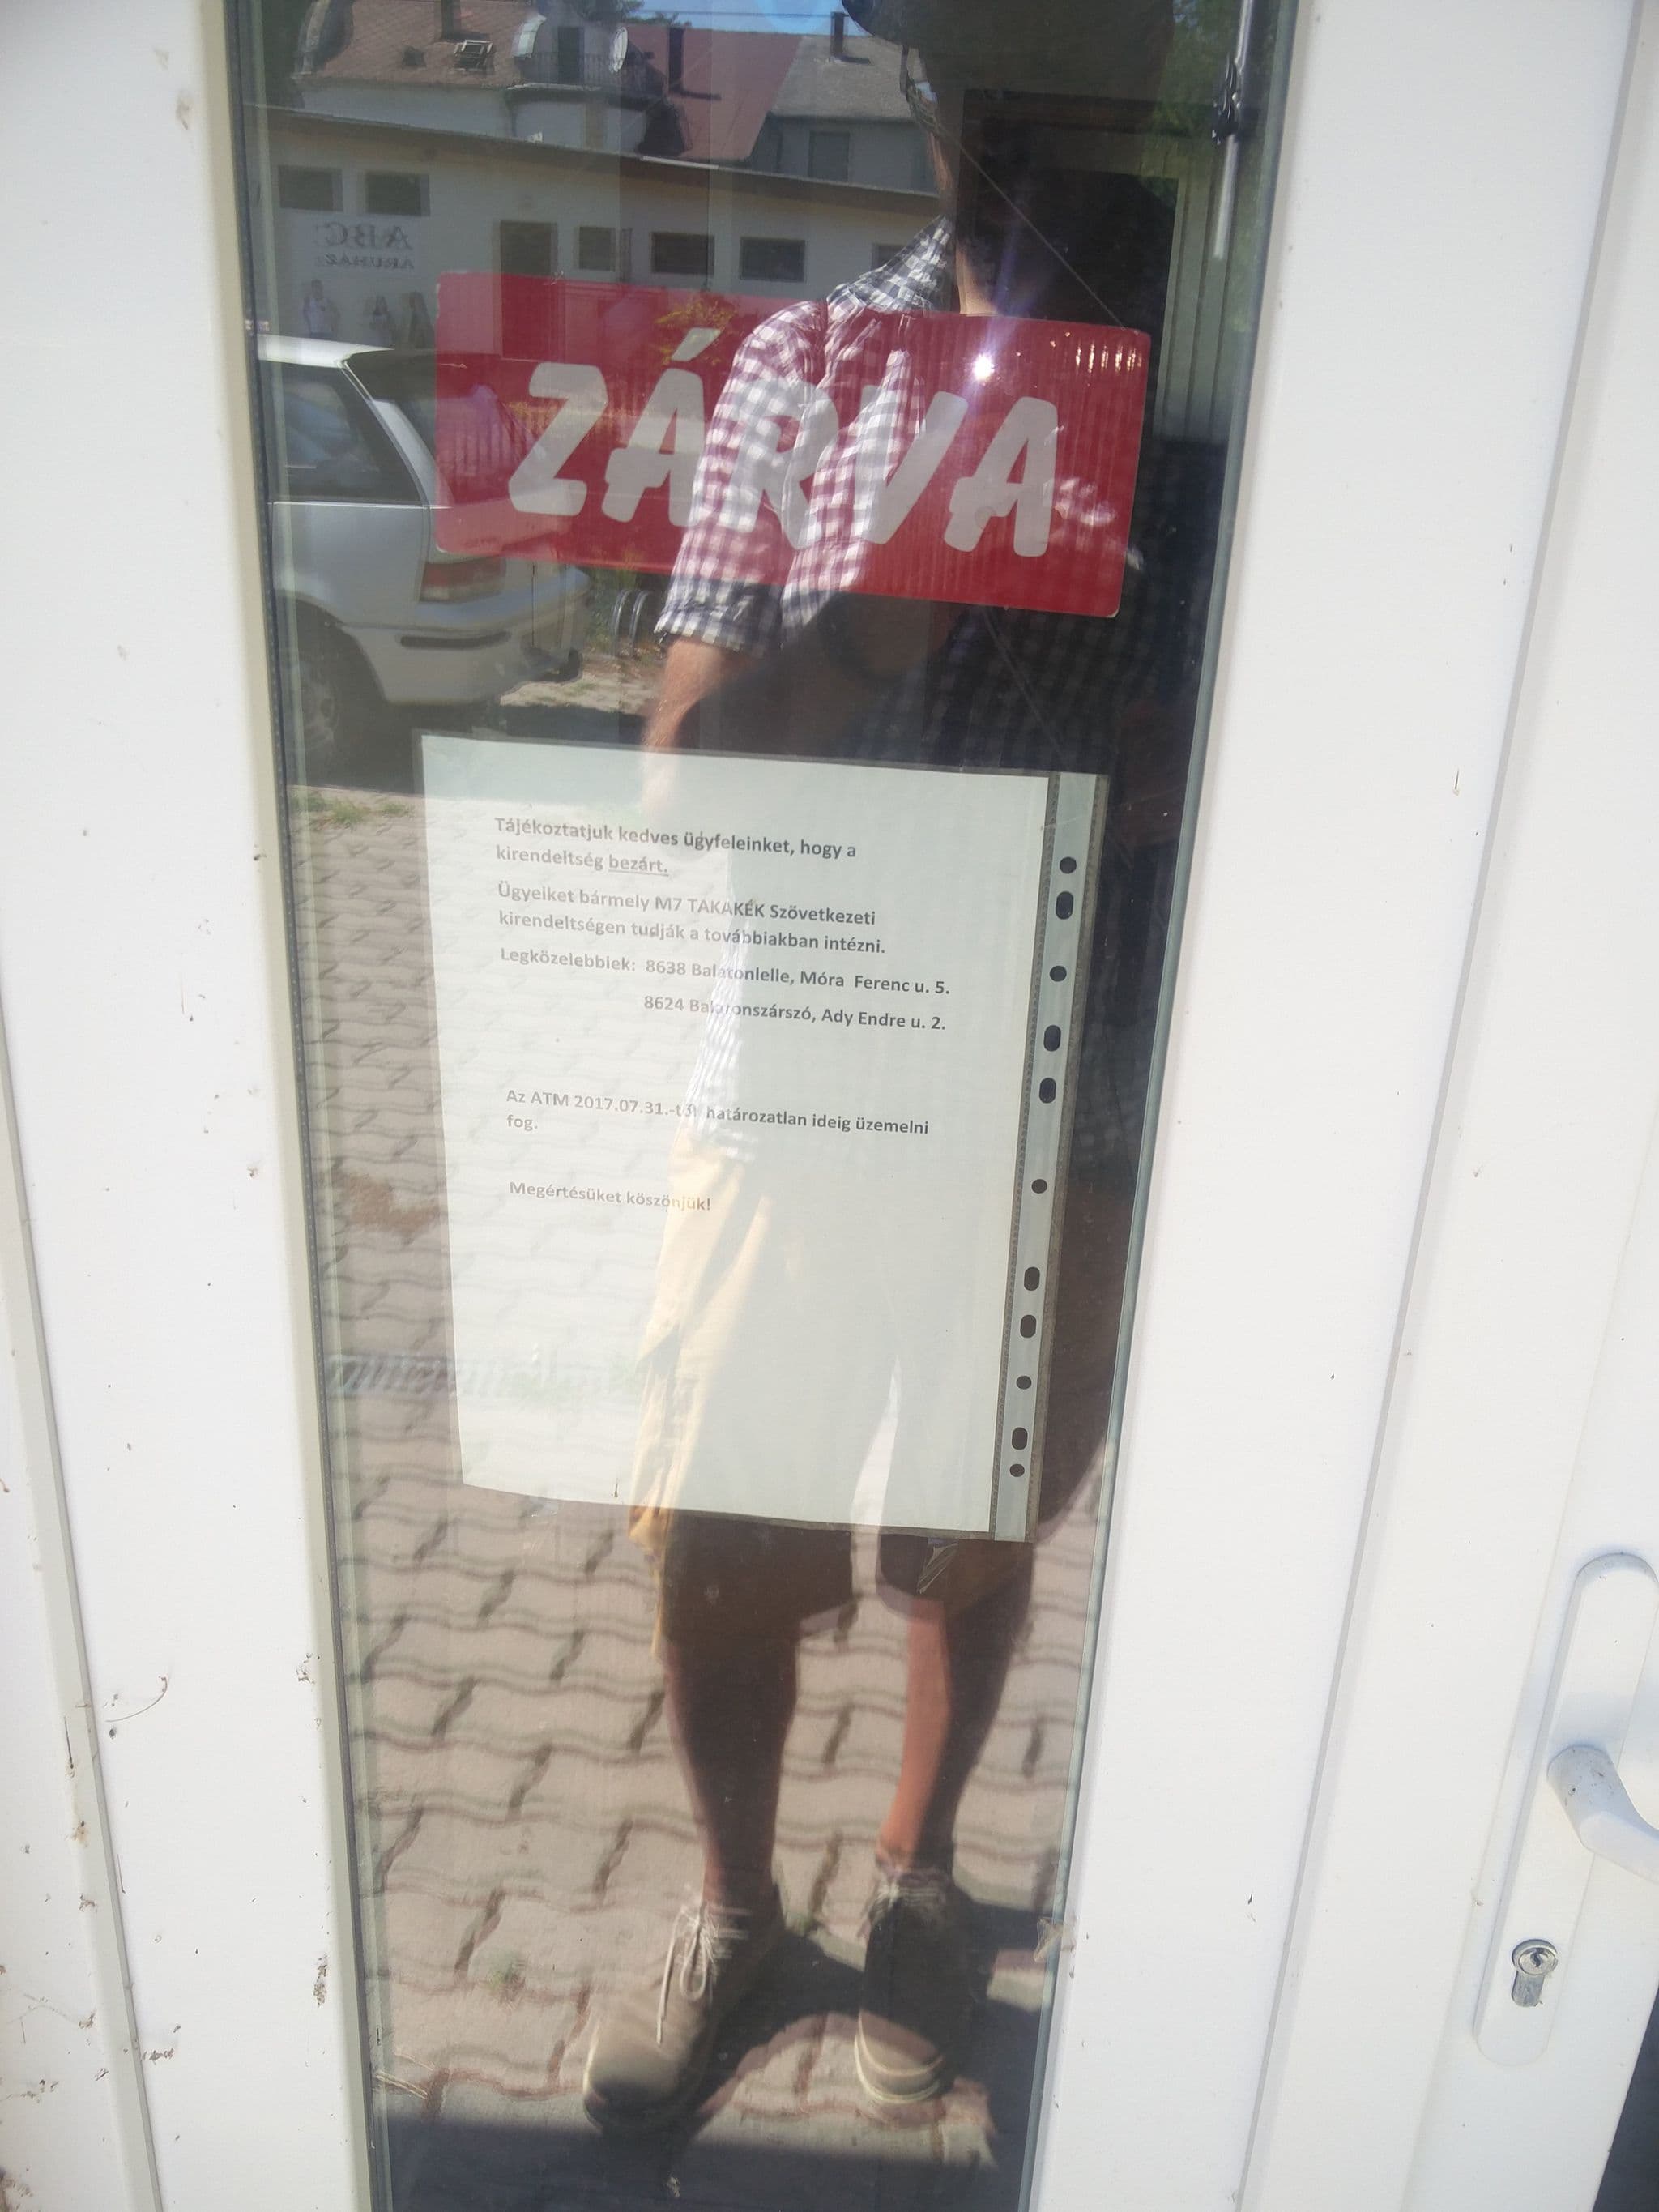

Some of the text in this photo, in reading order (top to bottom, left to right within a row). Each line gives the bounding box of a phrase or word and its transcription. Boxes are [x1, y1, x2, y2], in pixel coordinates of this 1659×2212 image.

[509, 327, 1060, 557] ZÁRVA
[495, 818, 856, 859] Tájékoztatjuk kedves ügyfeleinket, hogy a
[496, 845, 669, 874] kirendeltség bezárt.
[498, 880, 876, 925] Ügyeiket bármely M7 TAKAKÉK Szövetkezeti
[499, 911, 885, 954] kirendeltségen tudják a továbbiakban intézni.
[501, 948, 636, 971] Legközelebbiek:
[646, 960, 686, 975] 8638
[800, 971, 845, 987] Móra
[855, 975, 910, 992] Ferenc
[914, 982, 930, 994] u.
[935, 980, 949, 995] 5.
[644, 995, 684, 1012] 8624
[821, 1008, 853, 1027] Ady
[858, 1011, 906, 1027] Endre
[911, 1016, 926, 1029] u.
[931, 1016, 946, 1030] 2.
[505, 1089, 526, 1103] Az
[531, 1091, 569, 1107] ATM
[706, 1106, 807, 1126] határozatlan
[812, 1113, 851, 1132] ideig
[855, 1117, 928, 1134] üzemelni
[506, 1114, 538, 1132] fog.
[510, 1181, 711, 1211] Megértésüket köszönjük!
